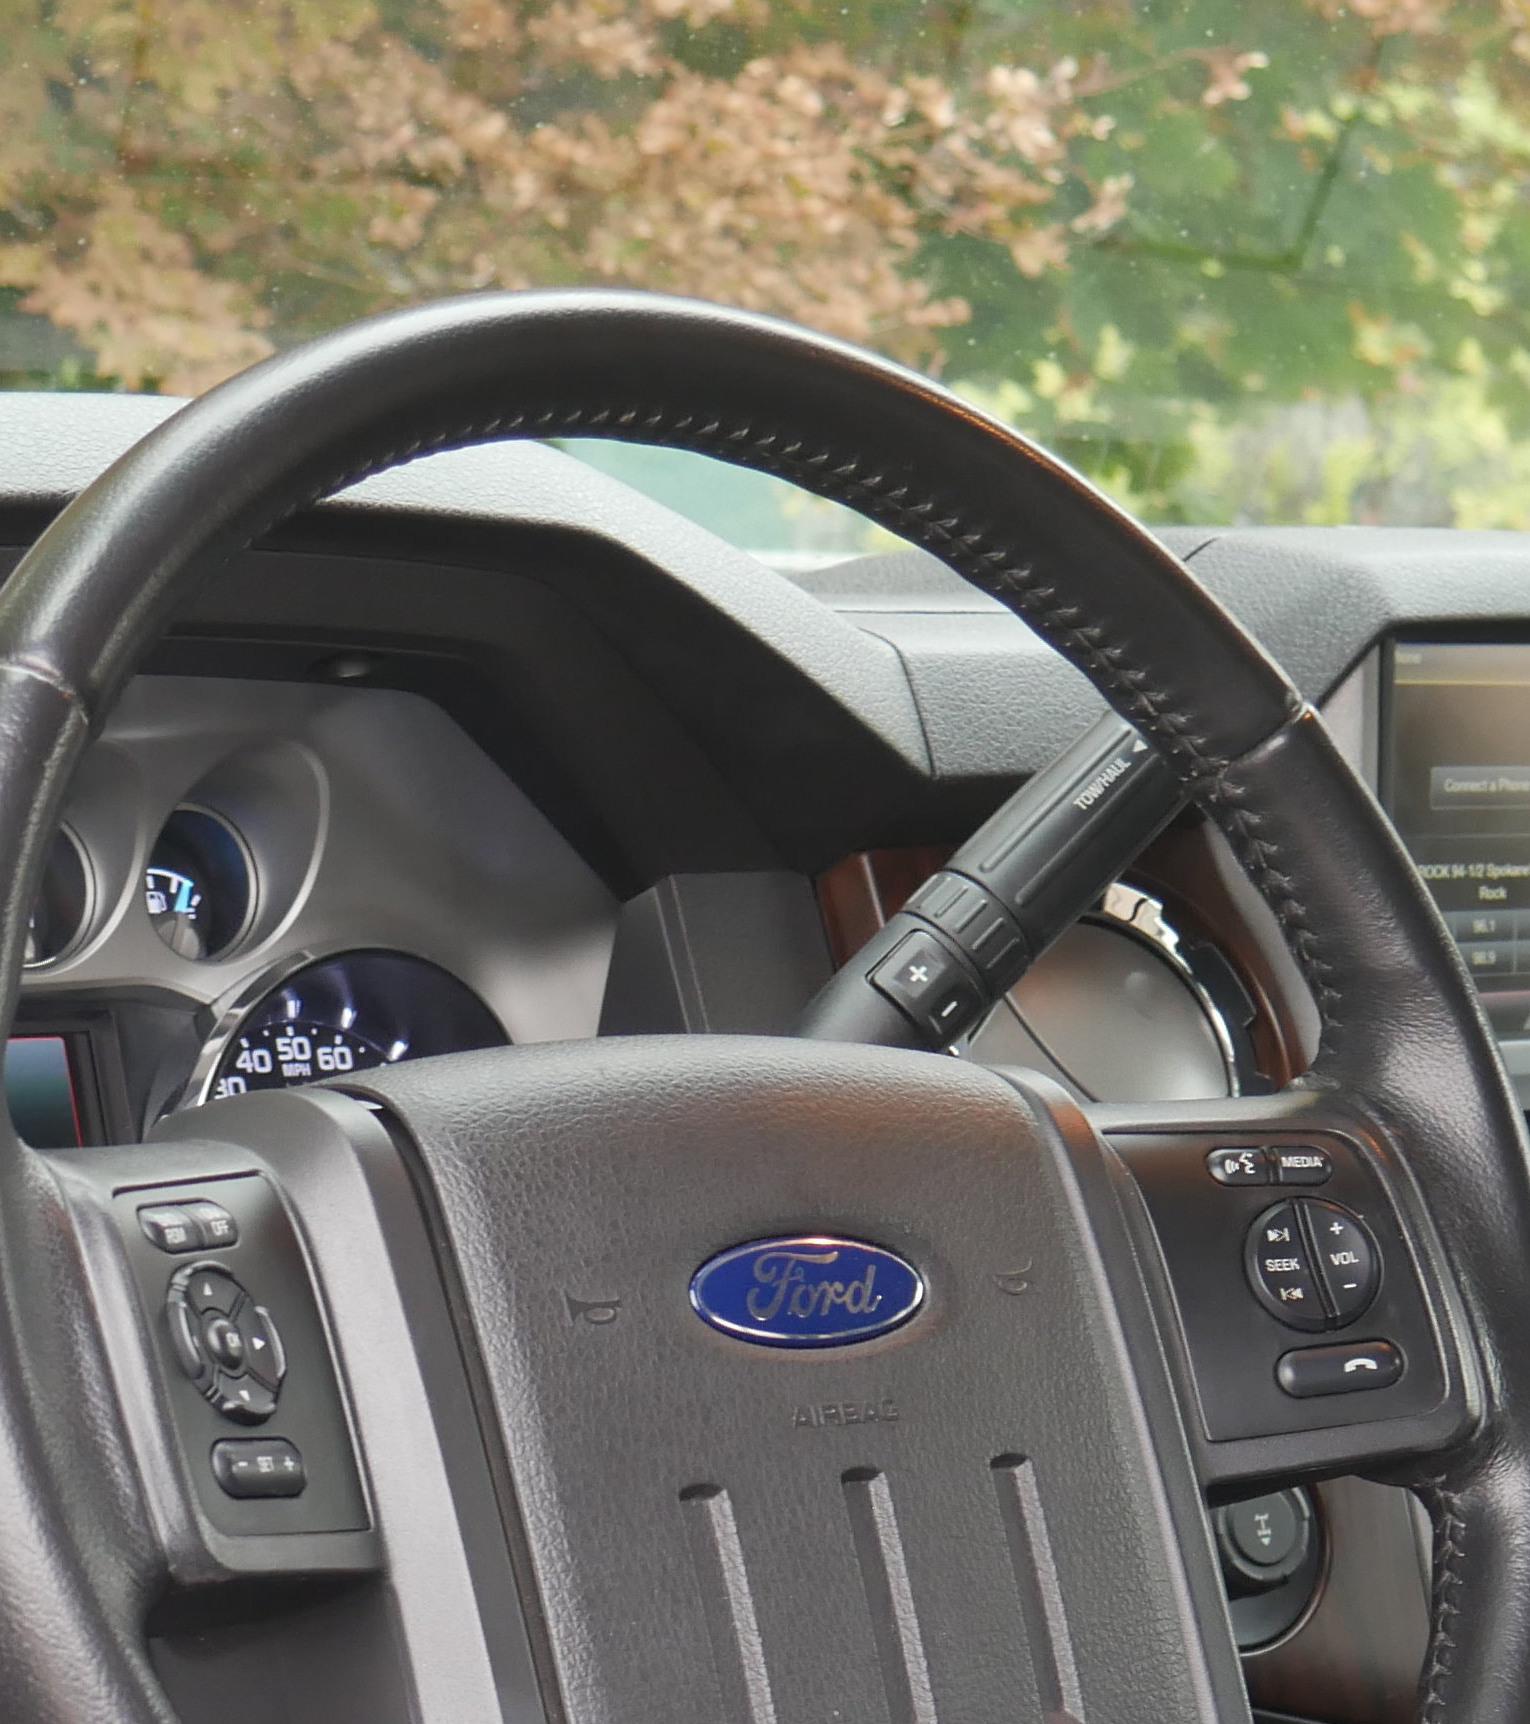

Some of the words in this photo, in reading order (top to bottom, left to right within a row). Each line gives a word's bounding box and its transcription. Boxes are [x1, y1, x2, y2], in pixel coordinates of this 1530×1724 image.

[275, 1036, 312, 1062] 50
[316, 1046, 353, 1071] 60
[235, 1047, 273, 1074] 40
[281, 1062, 312, 1077] MPH
[1281, 1156, 1324, 1169] MEDIA
[210, 1219, 230, 1237] OFF
[1265, 1257, 1301, 1272] SEEK
[1329, 1250, 1360, 1266] VOL
[747, 1251, 883, 1322] Ford
[791, 1399, 901, 1430] AIRBAG
